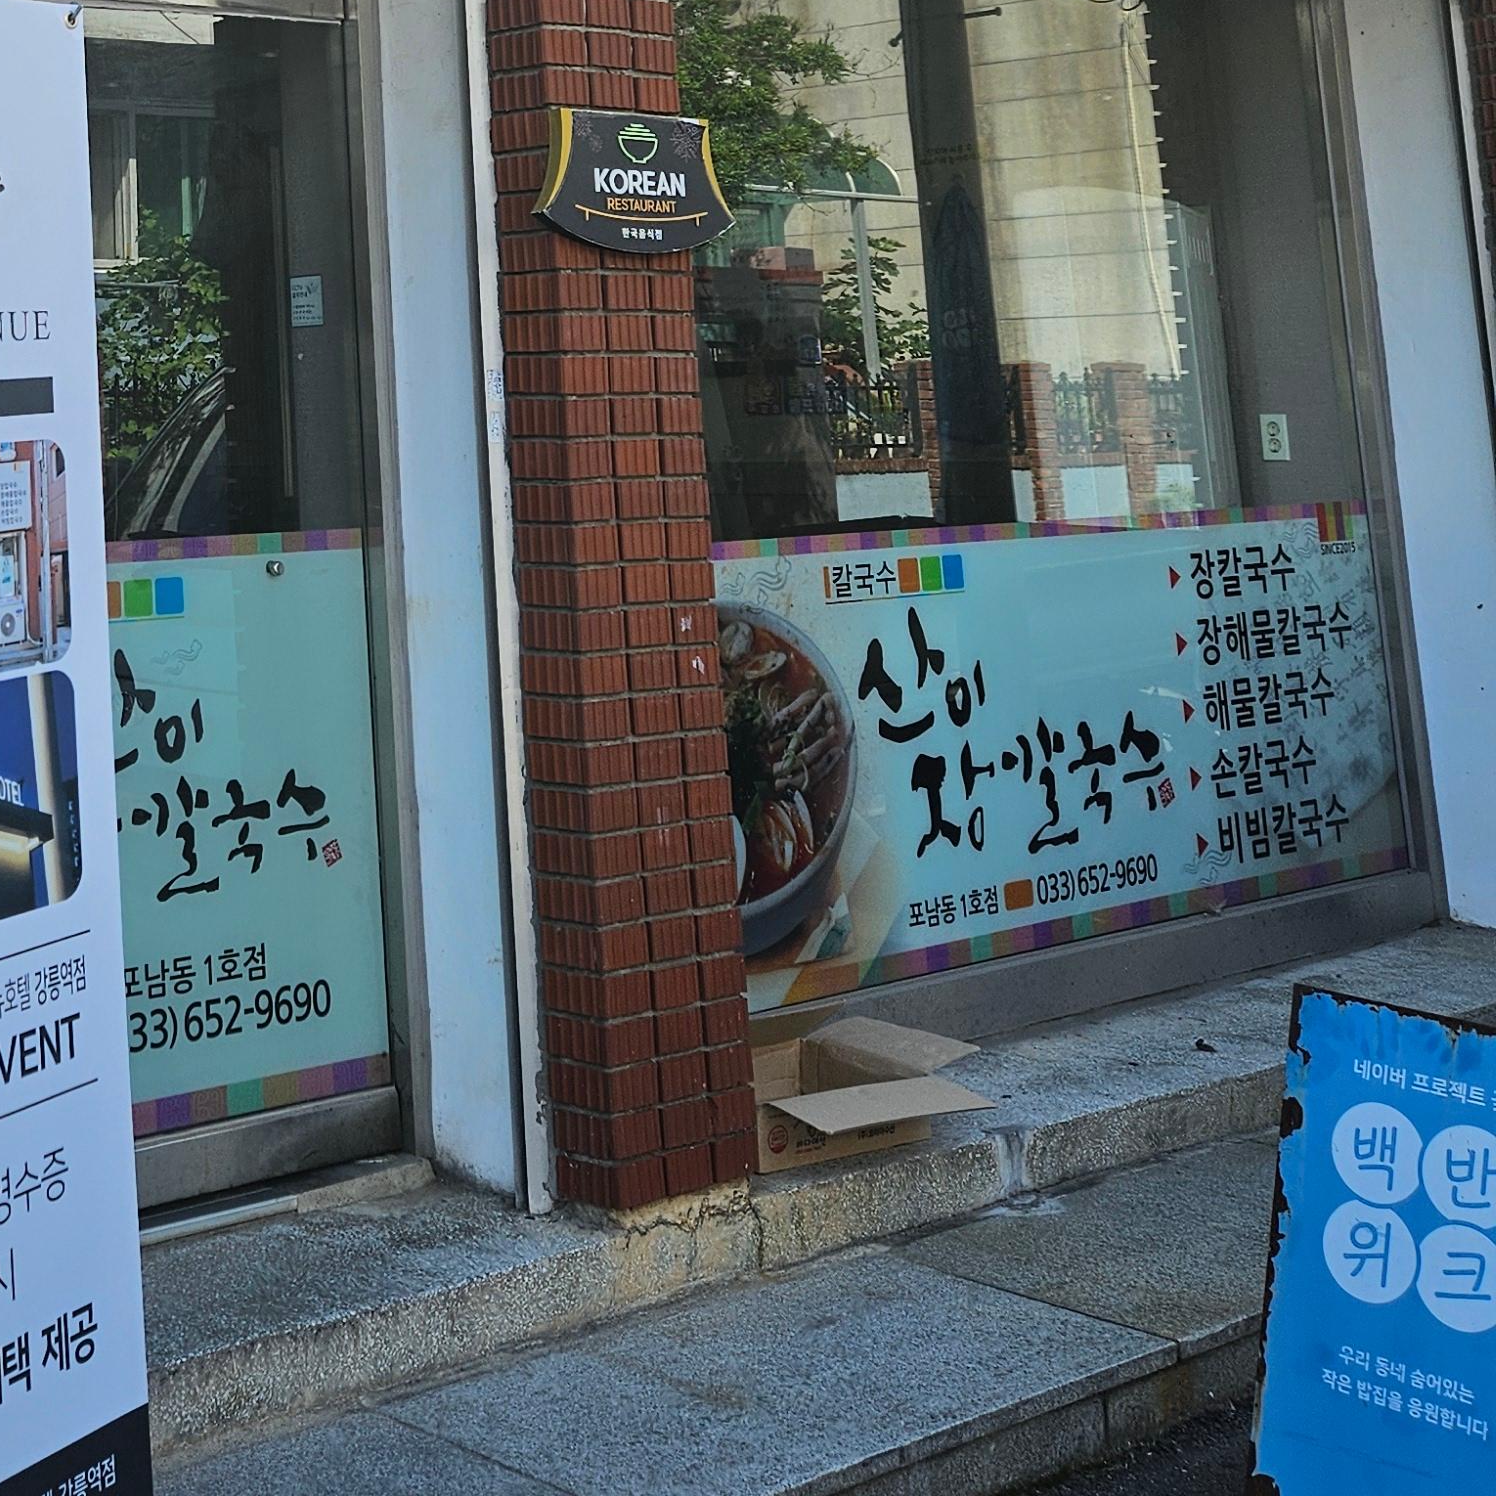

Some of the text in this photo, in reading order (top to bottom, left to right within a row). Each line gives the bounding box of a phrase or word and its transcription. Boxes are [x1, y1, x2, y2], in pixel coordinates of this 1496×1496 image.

[593, 167, 687, 198] KOREAN
[606, 197, 678, 214] RESTAURANT
[621, 227, 663, 241] 한국음식점
[832, 560, 897, 599] 칼국수
[1188, 542, 1297, 601] 장칼국수
[1196, 600, 1353, 668] 장해물칼국수
[858, 605, 985, 746] 산이
[1203, 666, 1336, 733] 해물칼국수
[910, 709, 1166, 859] 장칼국수
[1210, 734, 1318, 800] 손칼국수
[118, 768, 330, 903] 칼국수
[1217, 791, 1352, 865] 비빔칼국수
[908, 883, 1000, 931] 포남동 1호점
[1036, 852, 1159, 907] 033)652-9690
[35, 954, 87, 1006] 강릉역점
[204, 942, 267, 987] 1호점
[129, 979, 332, 1053] 33)652-9690
[1353, 1057, 1407, 1090] 네이버
[1411, 1072, 1486, 1107] 프로젝트
[41, 1300, 98, 1373] 제공
[1321, 1367, 1489, 1441] 작은 밥집을 응원합니다
[1338, 1344, 1475, 1406] 우리 동네 숨어있는
